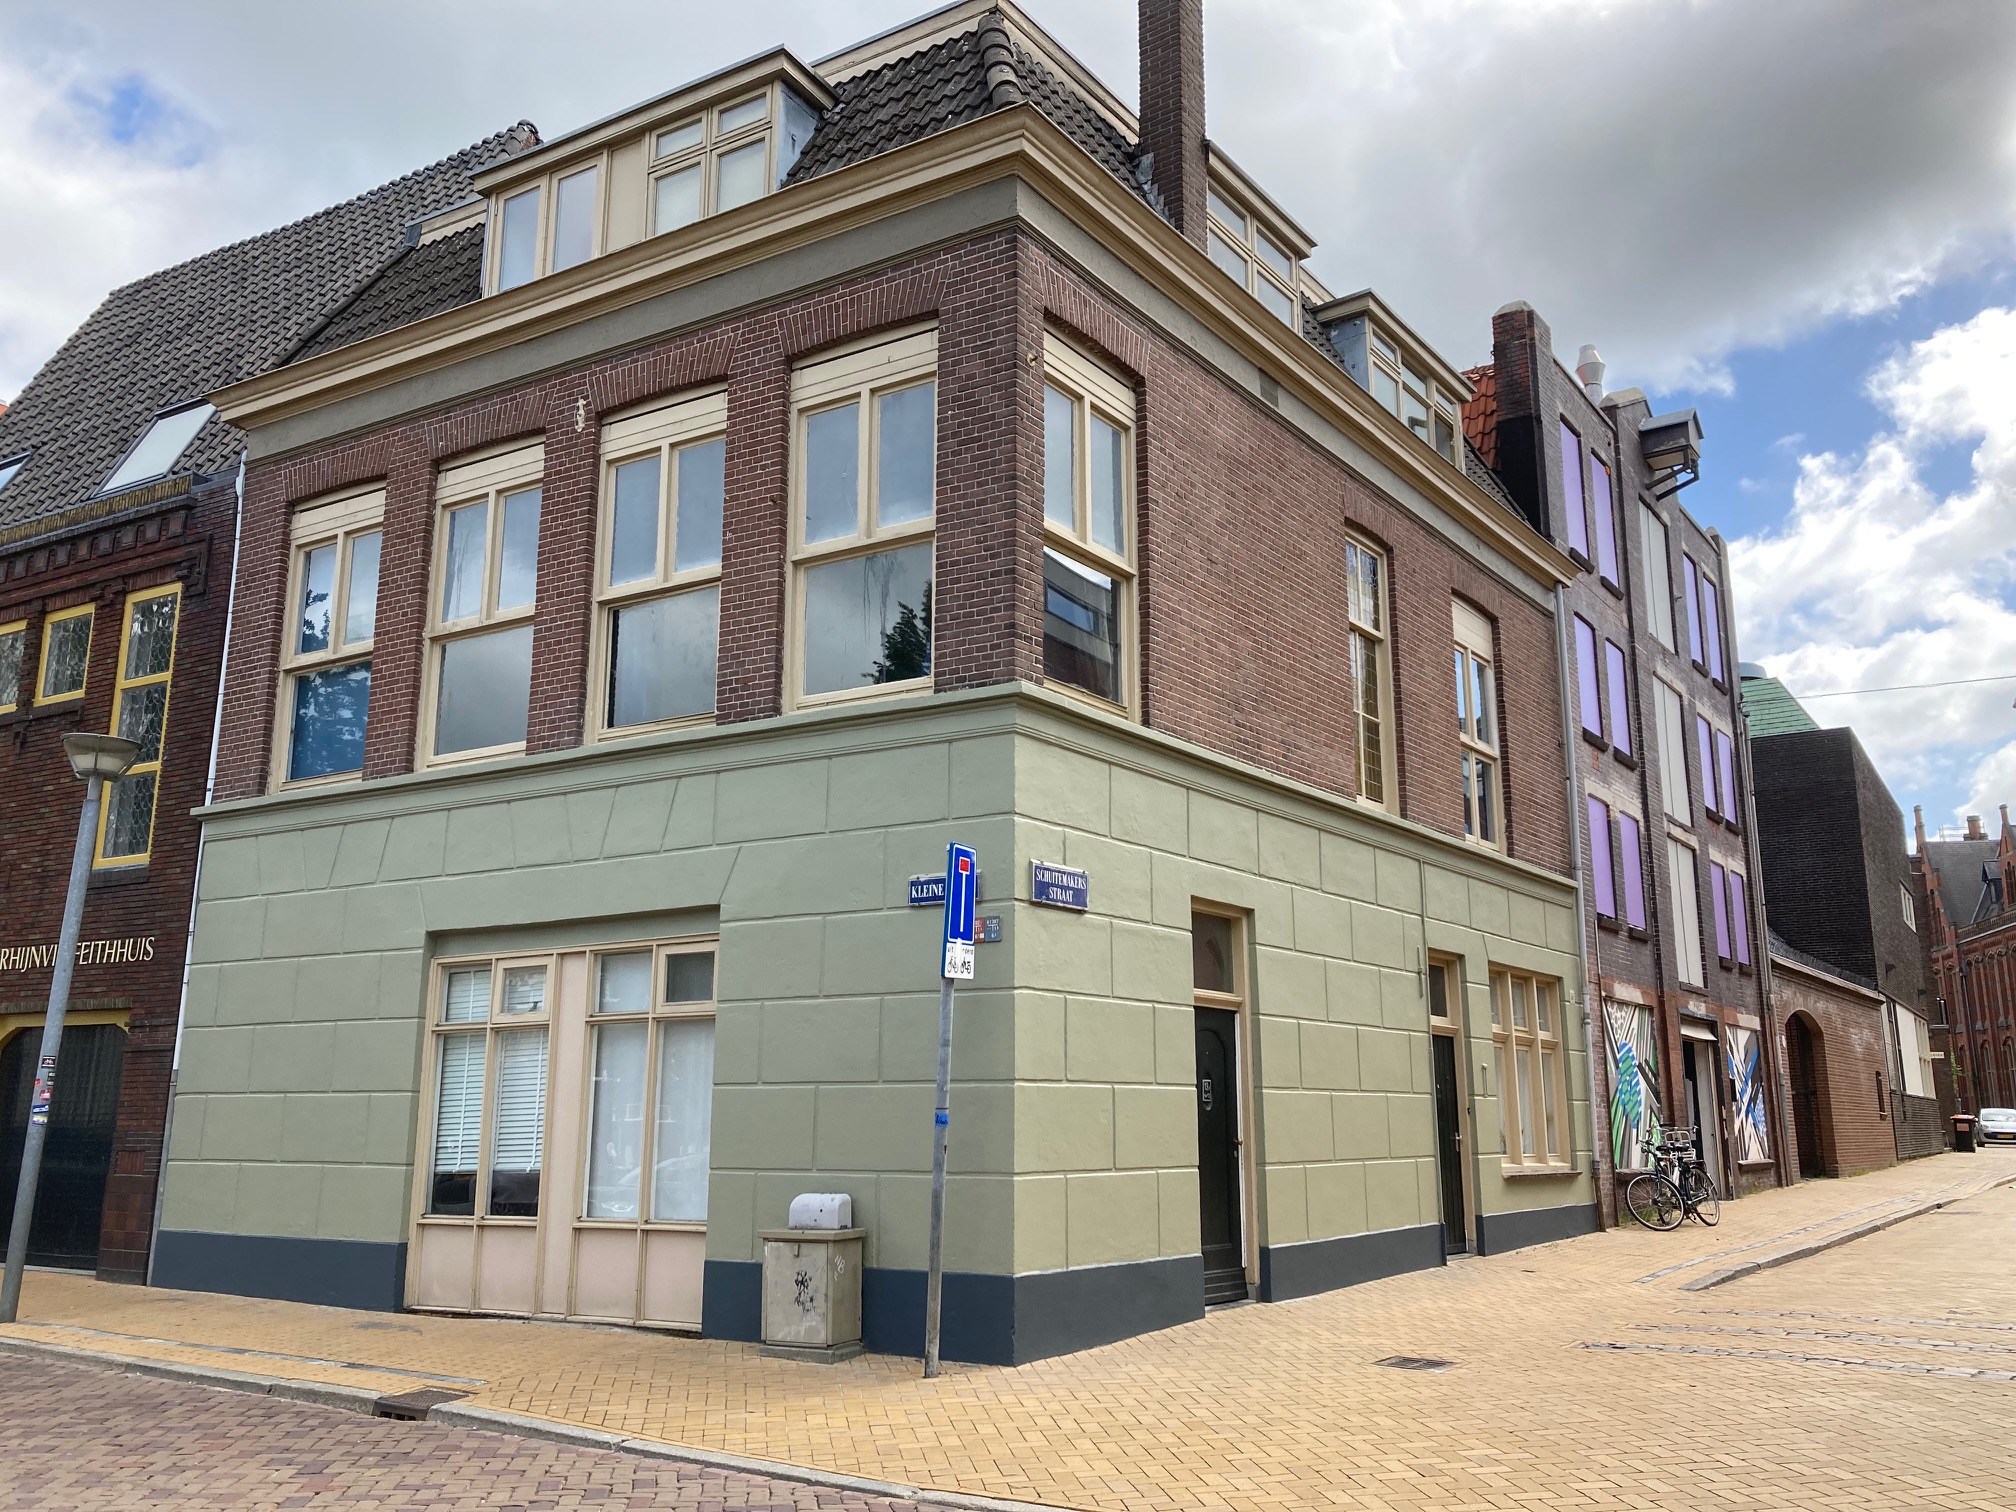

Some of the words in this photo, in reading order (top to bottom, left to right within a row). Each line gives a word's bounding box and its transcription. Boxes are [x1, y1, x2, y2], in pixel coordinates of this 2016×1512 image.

[1036, 869, 1086, 890] SCHUITEMAKERS
[911, 883, 944, 898] KLEINE
[1049, 886, 1073, 902] STRAAT
[0, 944, 58, 972] RHIJNVI
